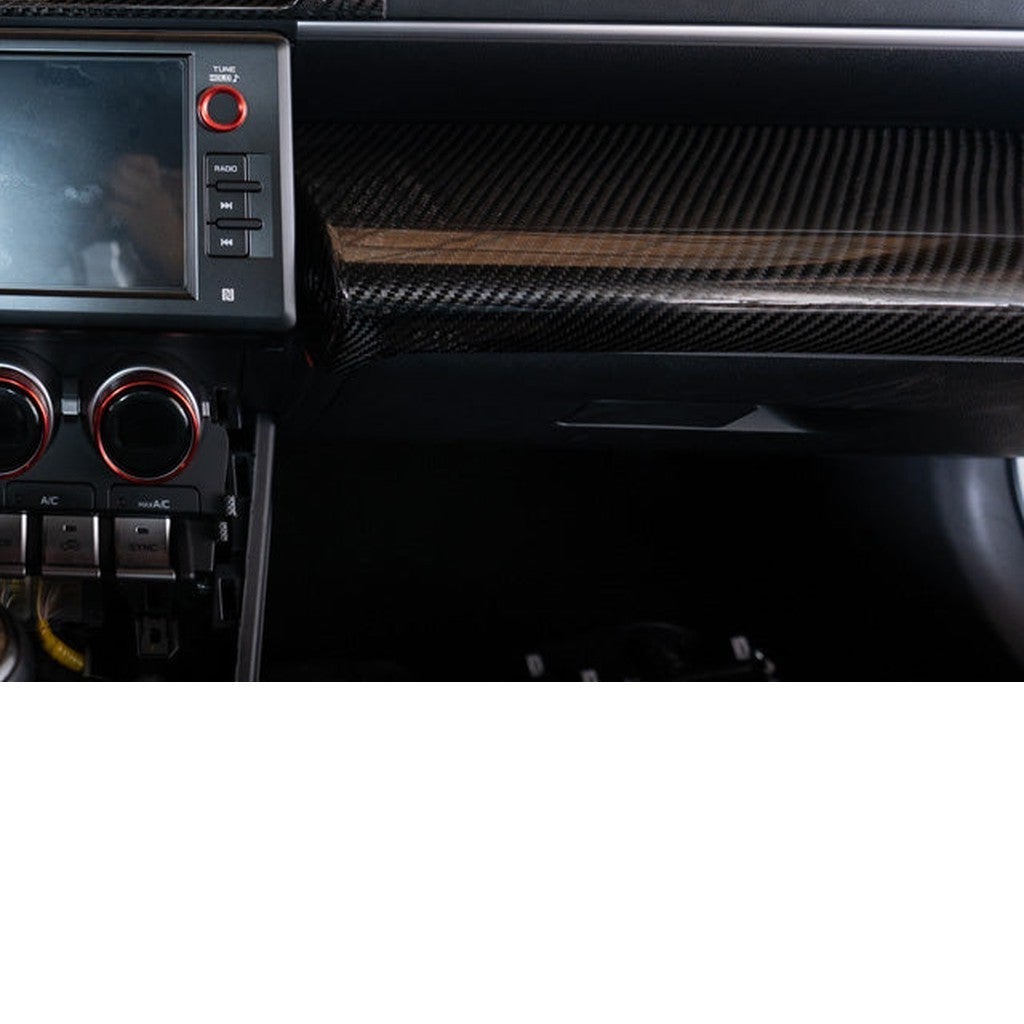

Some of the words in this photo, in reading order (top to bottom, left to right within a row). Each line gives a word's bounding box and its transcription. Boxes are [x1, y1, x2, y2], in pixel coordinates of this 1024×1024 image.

[213, 65, 236, 73] TUNE
[213, 164, 238, 173] RADIO
[40, 495, 60, 506] A/C
